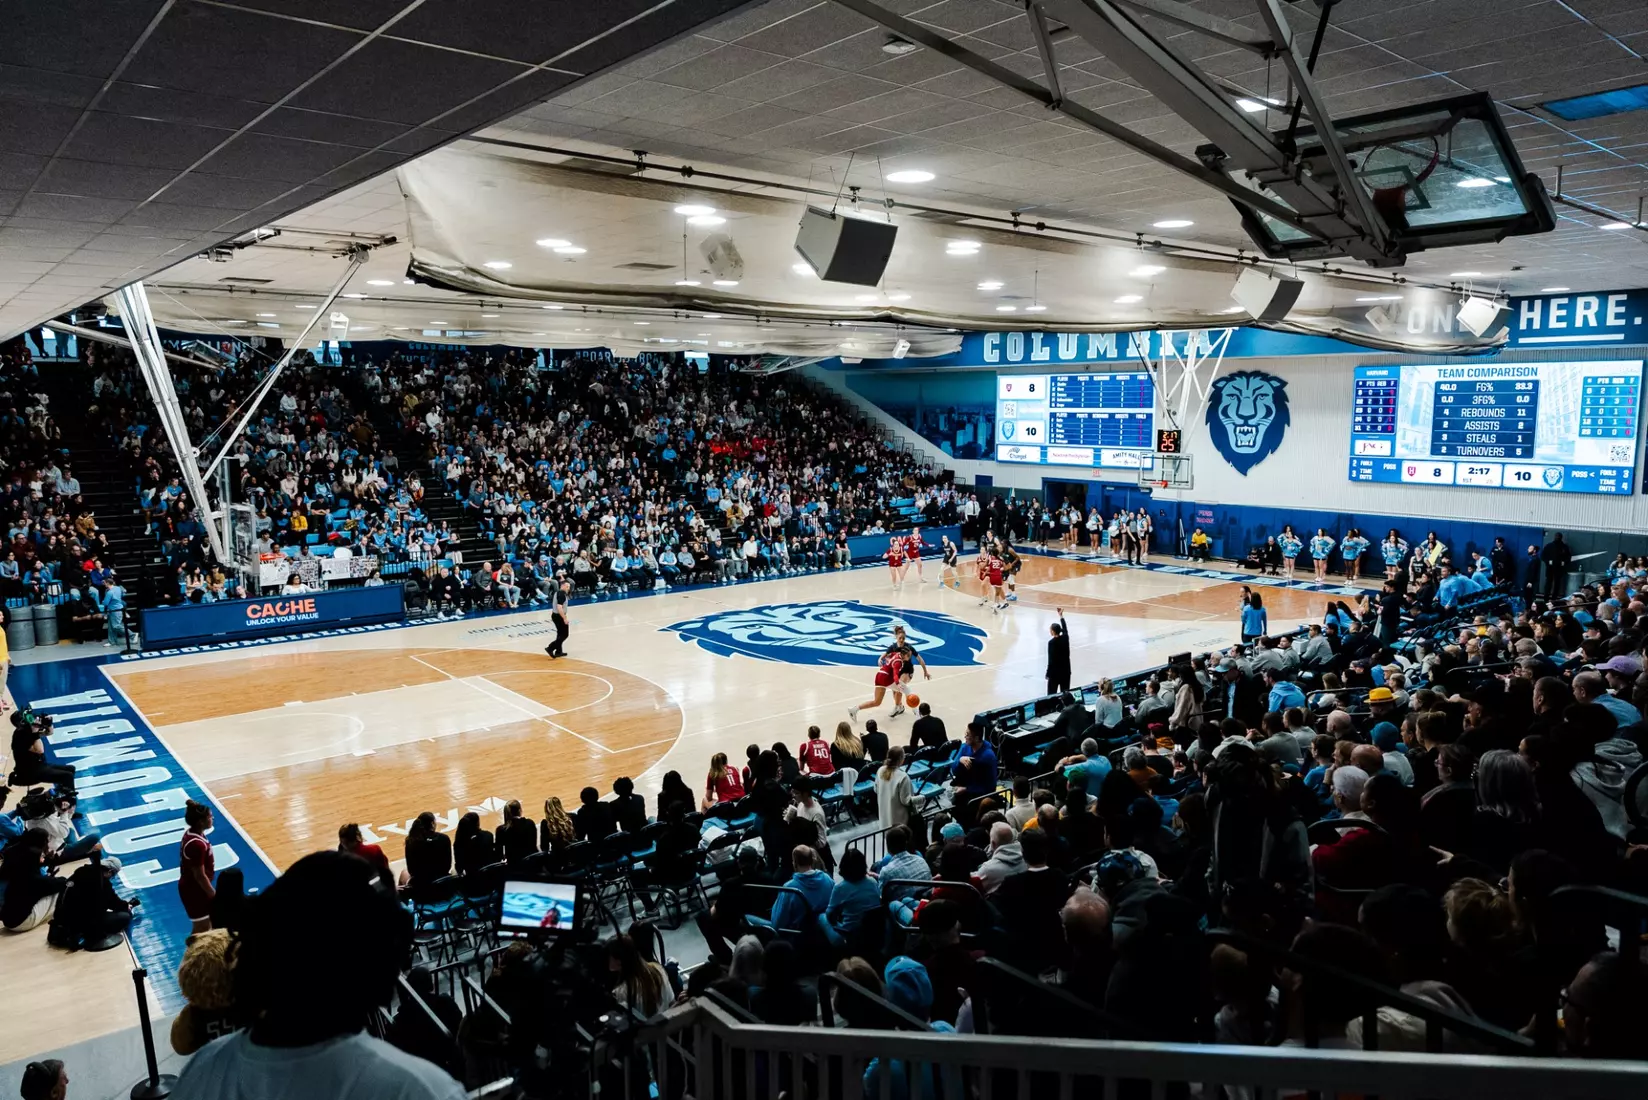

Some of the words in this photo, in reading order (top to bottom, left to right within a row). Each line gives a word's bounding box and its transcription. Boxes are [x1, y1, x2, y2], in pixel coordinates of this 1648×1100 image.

[1518, 293, 1642, 330] HERE.
[1437, 368, 1465, 378] TEAM
[1467, 367, 1538, 378] COMPARISON
[1029, 384, 1035, 392] 8
[1476, 382, 1494, 392] FG%
[1472, 396, 1496, 404] 3FG%
[1461, 408, 1506, 417] REBOUNDS
[1464, 421, 1500, 430] ASSISTS
[1026, 427, 1036, 436] 10
[1466, 434, 1496, 443] STEALS
[1161, 439, 1174, 452] 25
[1456, 446, 1505, 456] TURNOVERS
[1433, 468, 1442, 477] 8
[1468, 467, 1490, 475] 2:17
[1623, 470, 1629, 478] 3
[1514, 472, 1531, 481] 10
[246, 598, 316, 619] CACHE
[246, 616, 275, 626] UNLOCK
[276, 614, 296, 624] YOUR
[296, 612, 319, 621] VALUE
[814, 748, 828, 758] 40
[727, 774, 736, 786] 11
[29, 688, 240, 888] COLUMBIA
